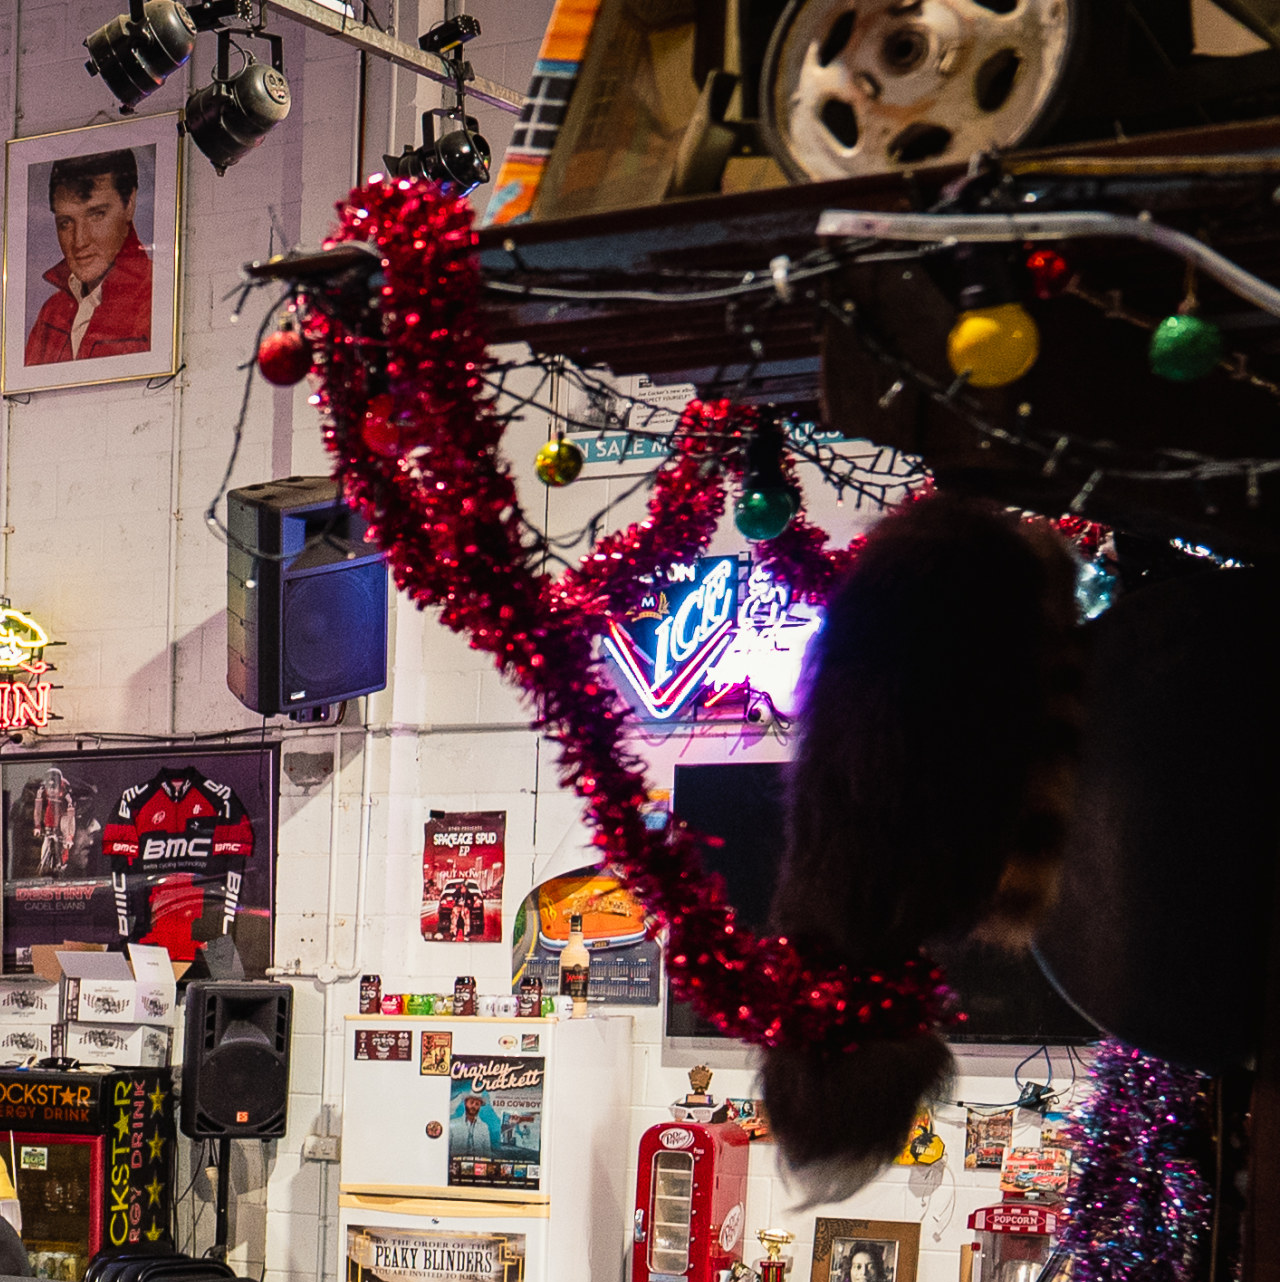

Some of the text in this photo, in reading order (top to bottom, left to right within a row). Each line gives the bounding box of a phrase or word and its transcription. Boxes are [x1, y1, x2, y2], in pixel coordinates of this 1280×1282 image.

[596, 439, 645, 458] SALE
[117, 783, 150, 820] BMC
[474, 832, 498, 845] SPUD
[112, 841, 140, 854] BMC
[142, 837, 212, 861] BMC
[213, 841, 242, 853] BMC
[457, 845, 471, 857] EP
[15, 886, 96, 901] DESTINY
[23, 900, 86, 912] CADEL EVANS
[450, 1060, 525, 1080] Charley
[471, 1069, 545, 1094] Crockett
[506, 1099, 542, 1108] COWBOY
[43, 1104, 90, 1123] DRINK
[130, 1079, 147, 1169] DRINK
[993, 1214, 1038, 1225] POPCORN
[388, 1238, 411, 1247] THE
[413, 1240, 448, 1249] ORDER
[451, 1242, 466, 1250] OF
[374, 1245, 493, 1274] PEAKY BLINDERS
[374, 1267, 492, 1281] YOU ARE INVITED TO JOIN US
